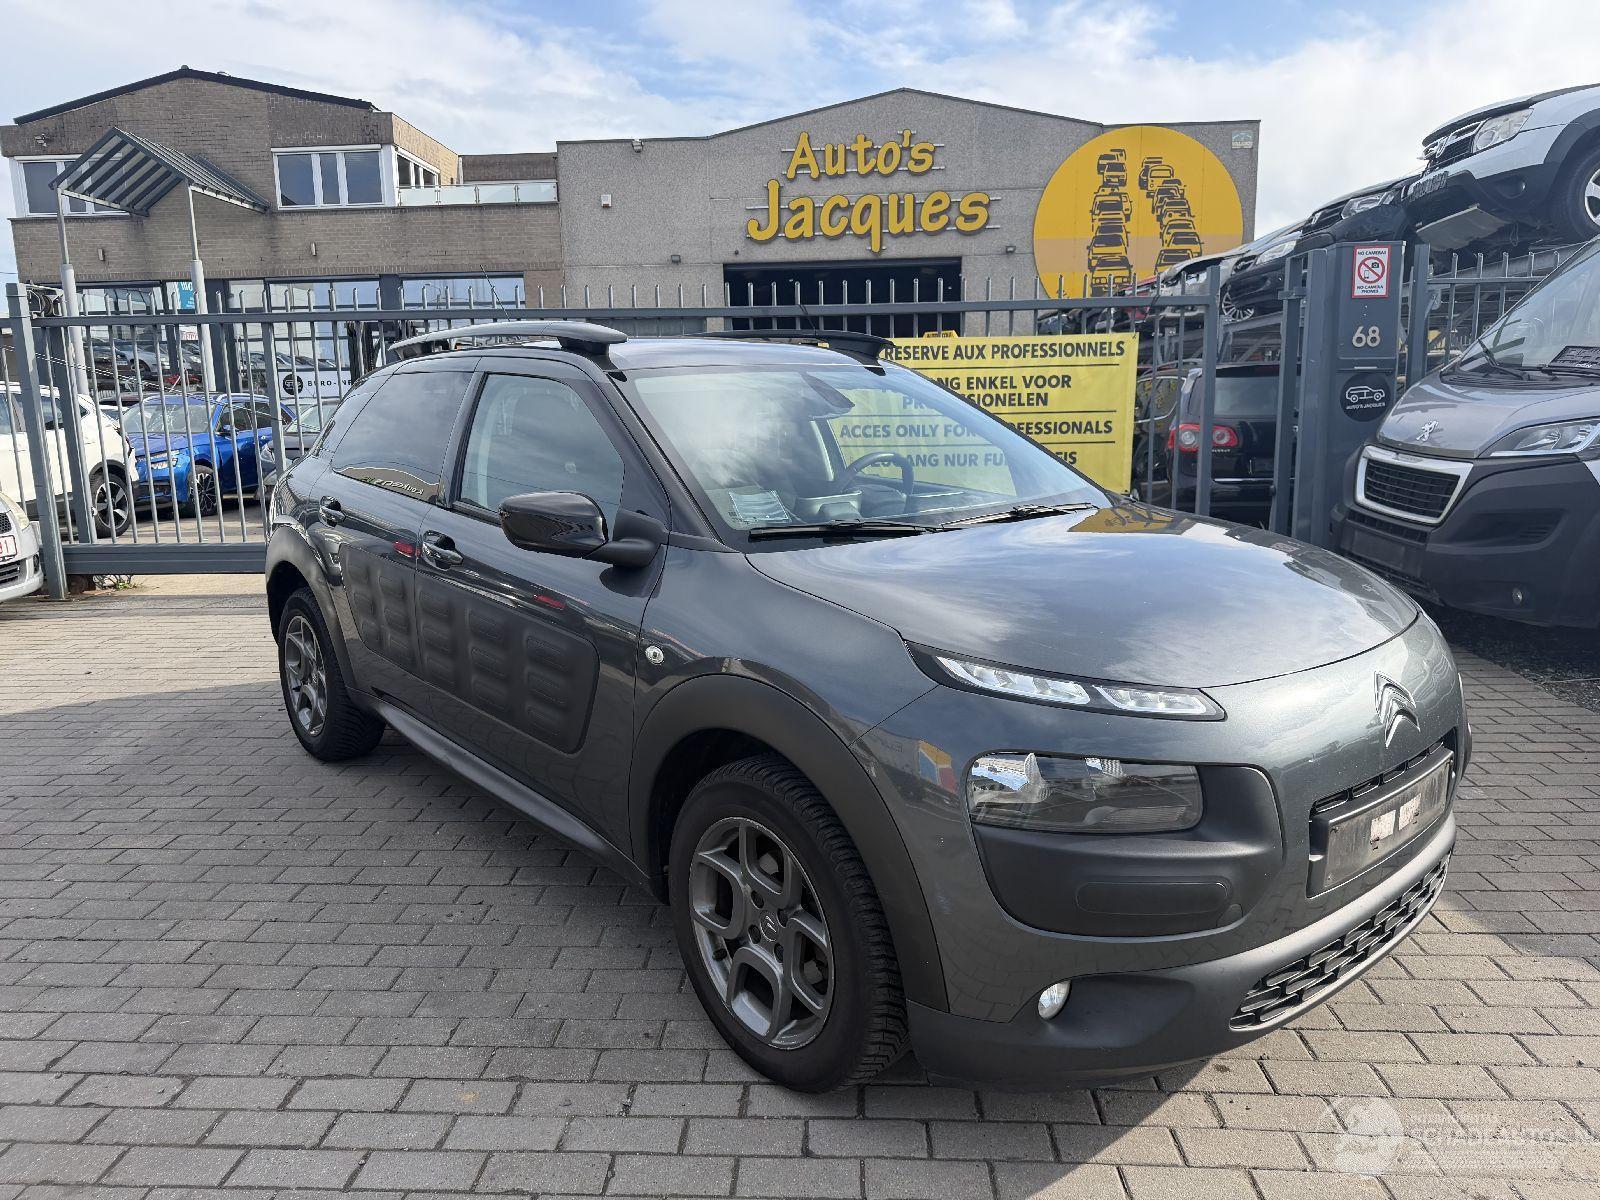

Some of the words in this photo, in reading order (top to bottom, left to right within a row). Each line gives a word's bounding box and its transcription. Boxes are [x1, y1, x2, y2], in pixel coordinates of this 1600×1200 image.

[786, 129, 935, 179] Auto's
[747, 179, 990, 253] Jacques
[1352, 326, 1380, 347] 68
[884, 345, 949, 360] RESERVE
[953, 344, 987, 360] AUX
[991, 341, 1125, 359] PROFESSIONNELS
[966, 376, 1017, 391] ENKEL
[1022, 375, 1072, 389] VOOR
[840, 424, 891, 438] ACCES
[895, 424, 939, 438] ONLY
[944, 454, 979, 467] NUR
